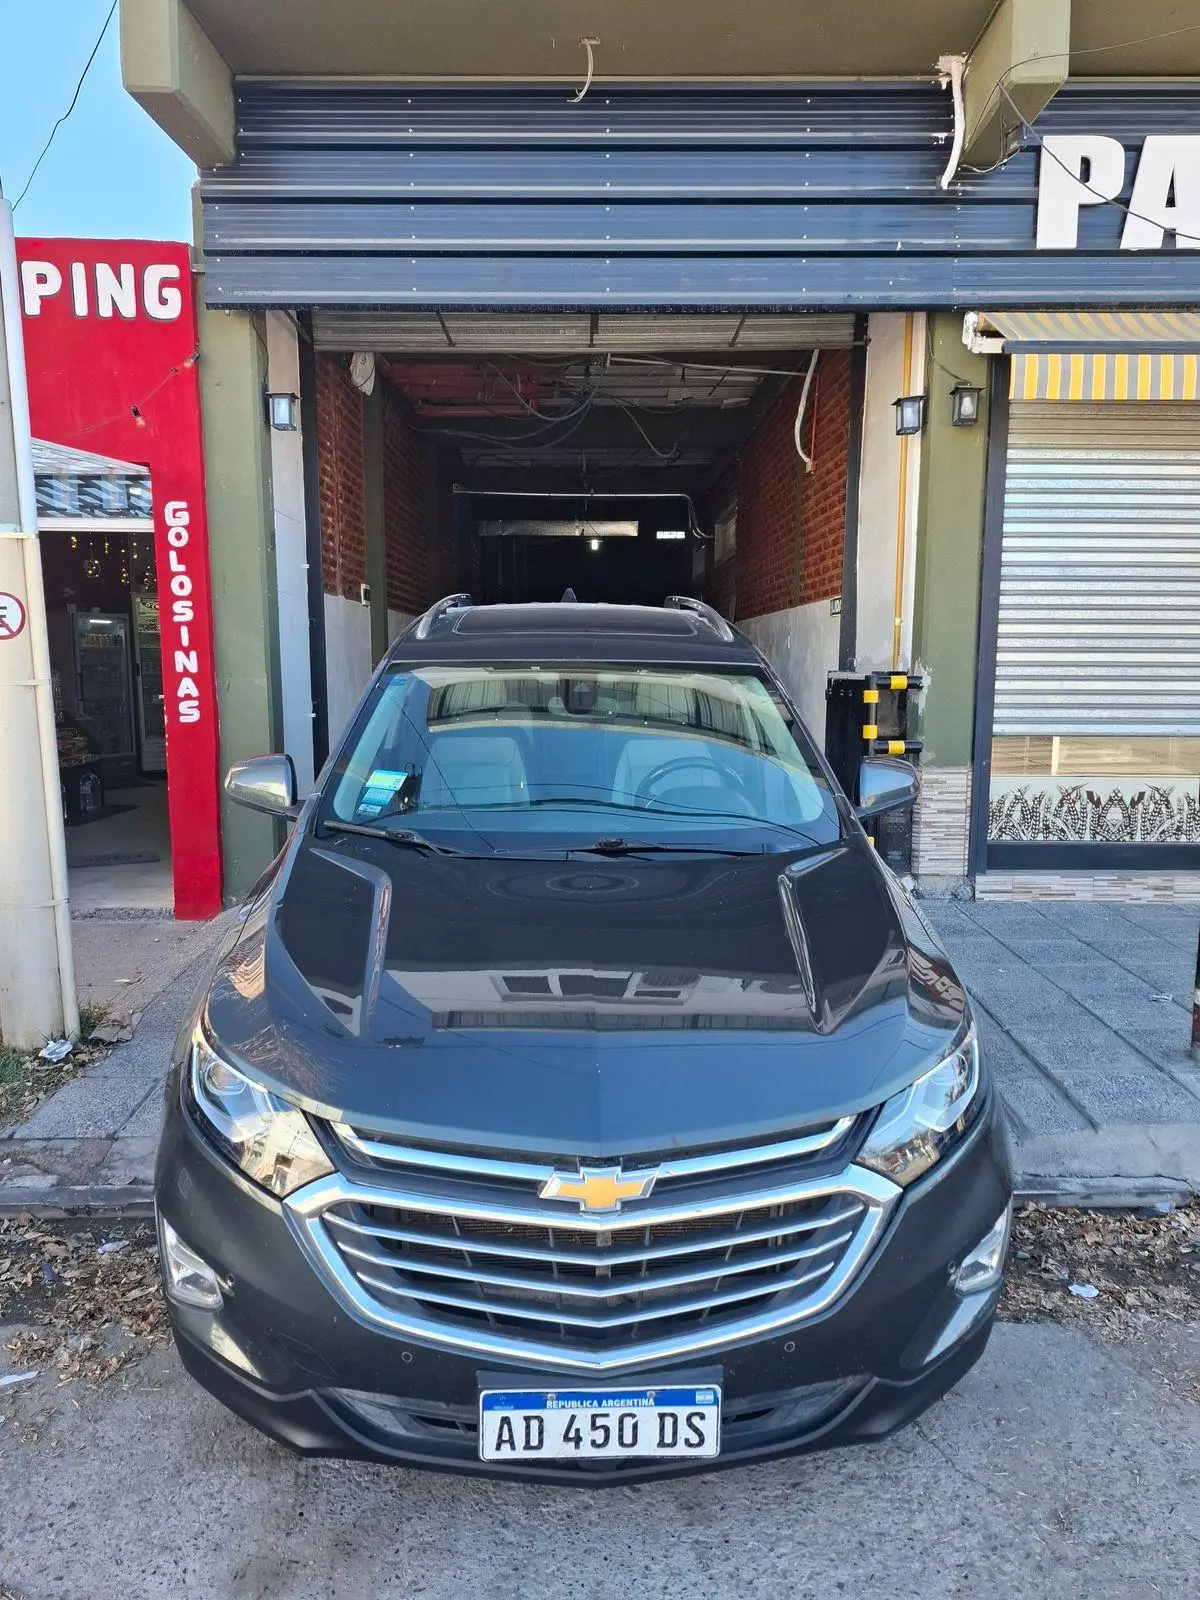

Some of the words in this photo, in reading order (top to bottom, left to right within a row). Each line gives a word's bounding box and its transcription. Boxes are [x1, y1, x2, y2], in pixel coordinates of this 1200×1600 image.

[1036, 134, 1200, 250] PA
[20, 260, 183, 320] PING
[164, 500, 200, 723] GOLOSINAS
[495, 1415, 544, 1451] AD
[562, 1412, 639, 1450] 450
[656, 1411, 706, 1448] DS
[546, 1399, 599, 1409] REPUBLICA
[602, 1398, 655, 1408] ARGENTINA
